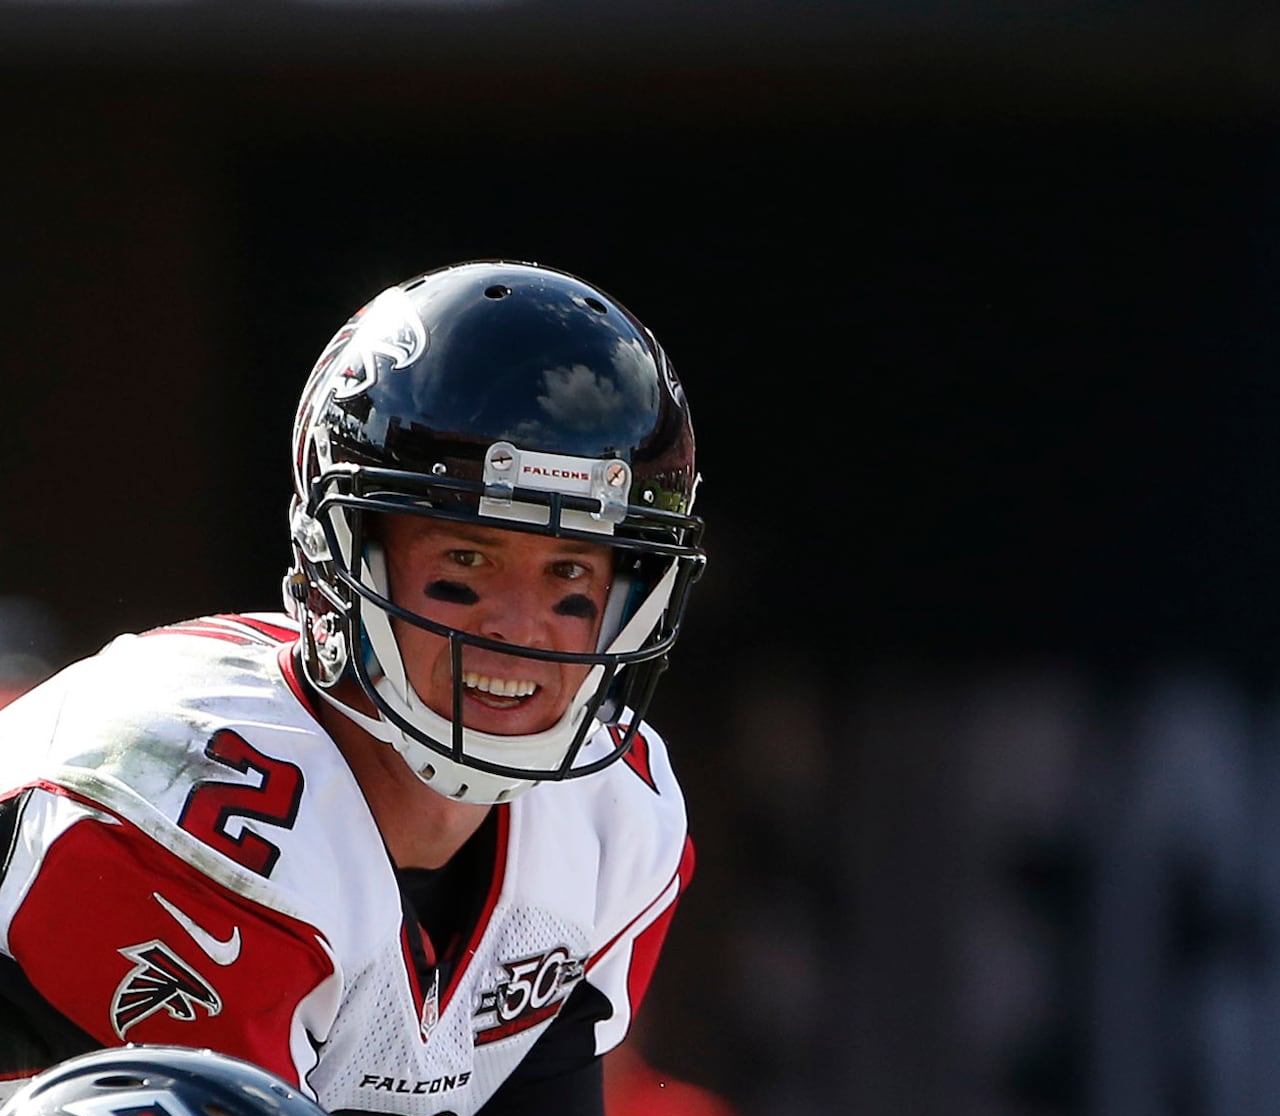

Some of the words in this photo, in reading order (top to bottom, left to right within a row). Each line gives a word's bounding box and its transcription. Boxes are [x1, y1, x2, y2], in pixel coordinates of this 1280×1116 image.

[522, 466, 589, 480] FALCONS
[178, 728, 304, 878] 2
[500, 950, 566, 1020] 50
[360, 1072, 472, 1096] FALCONS
